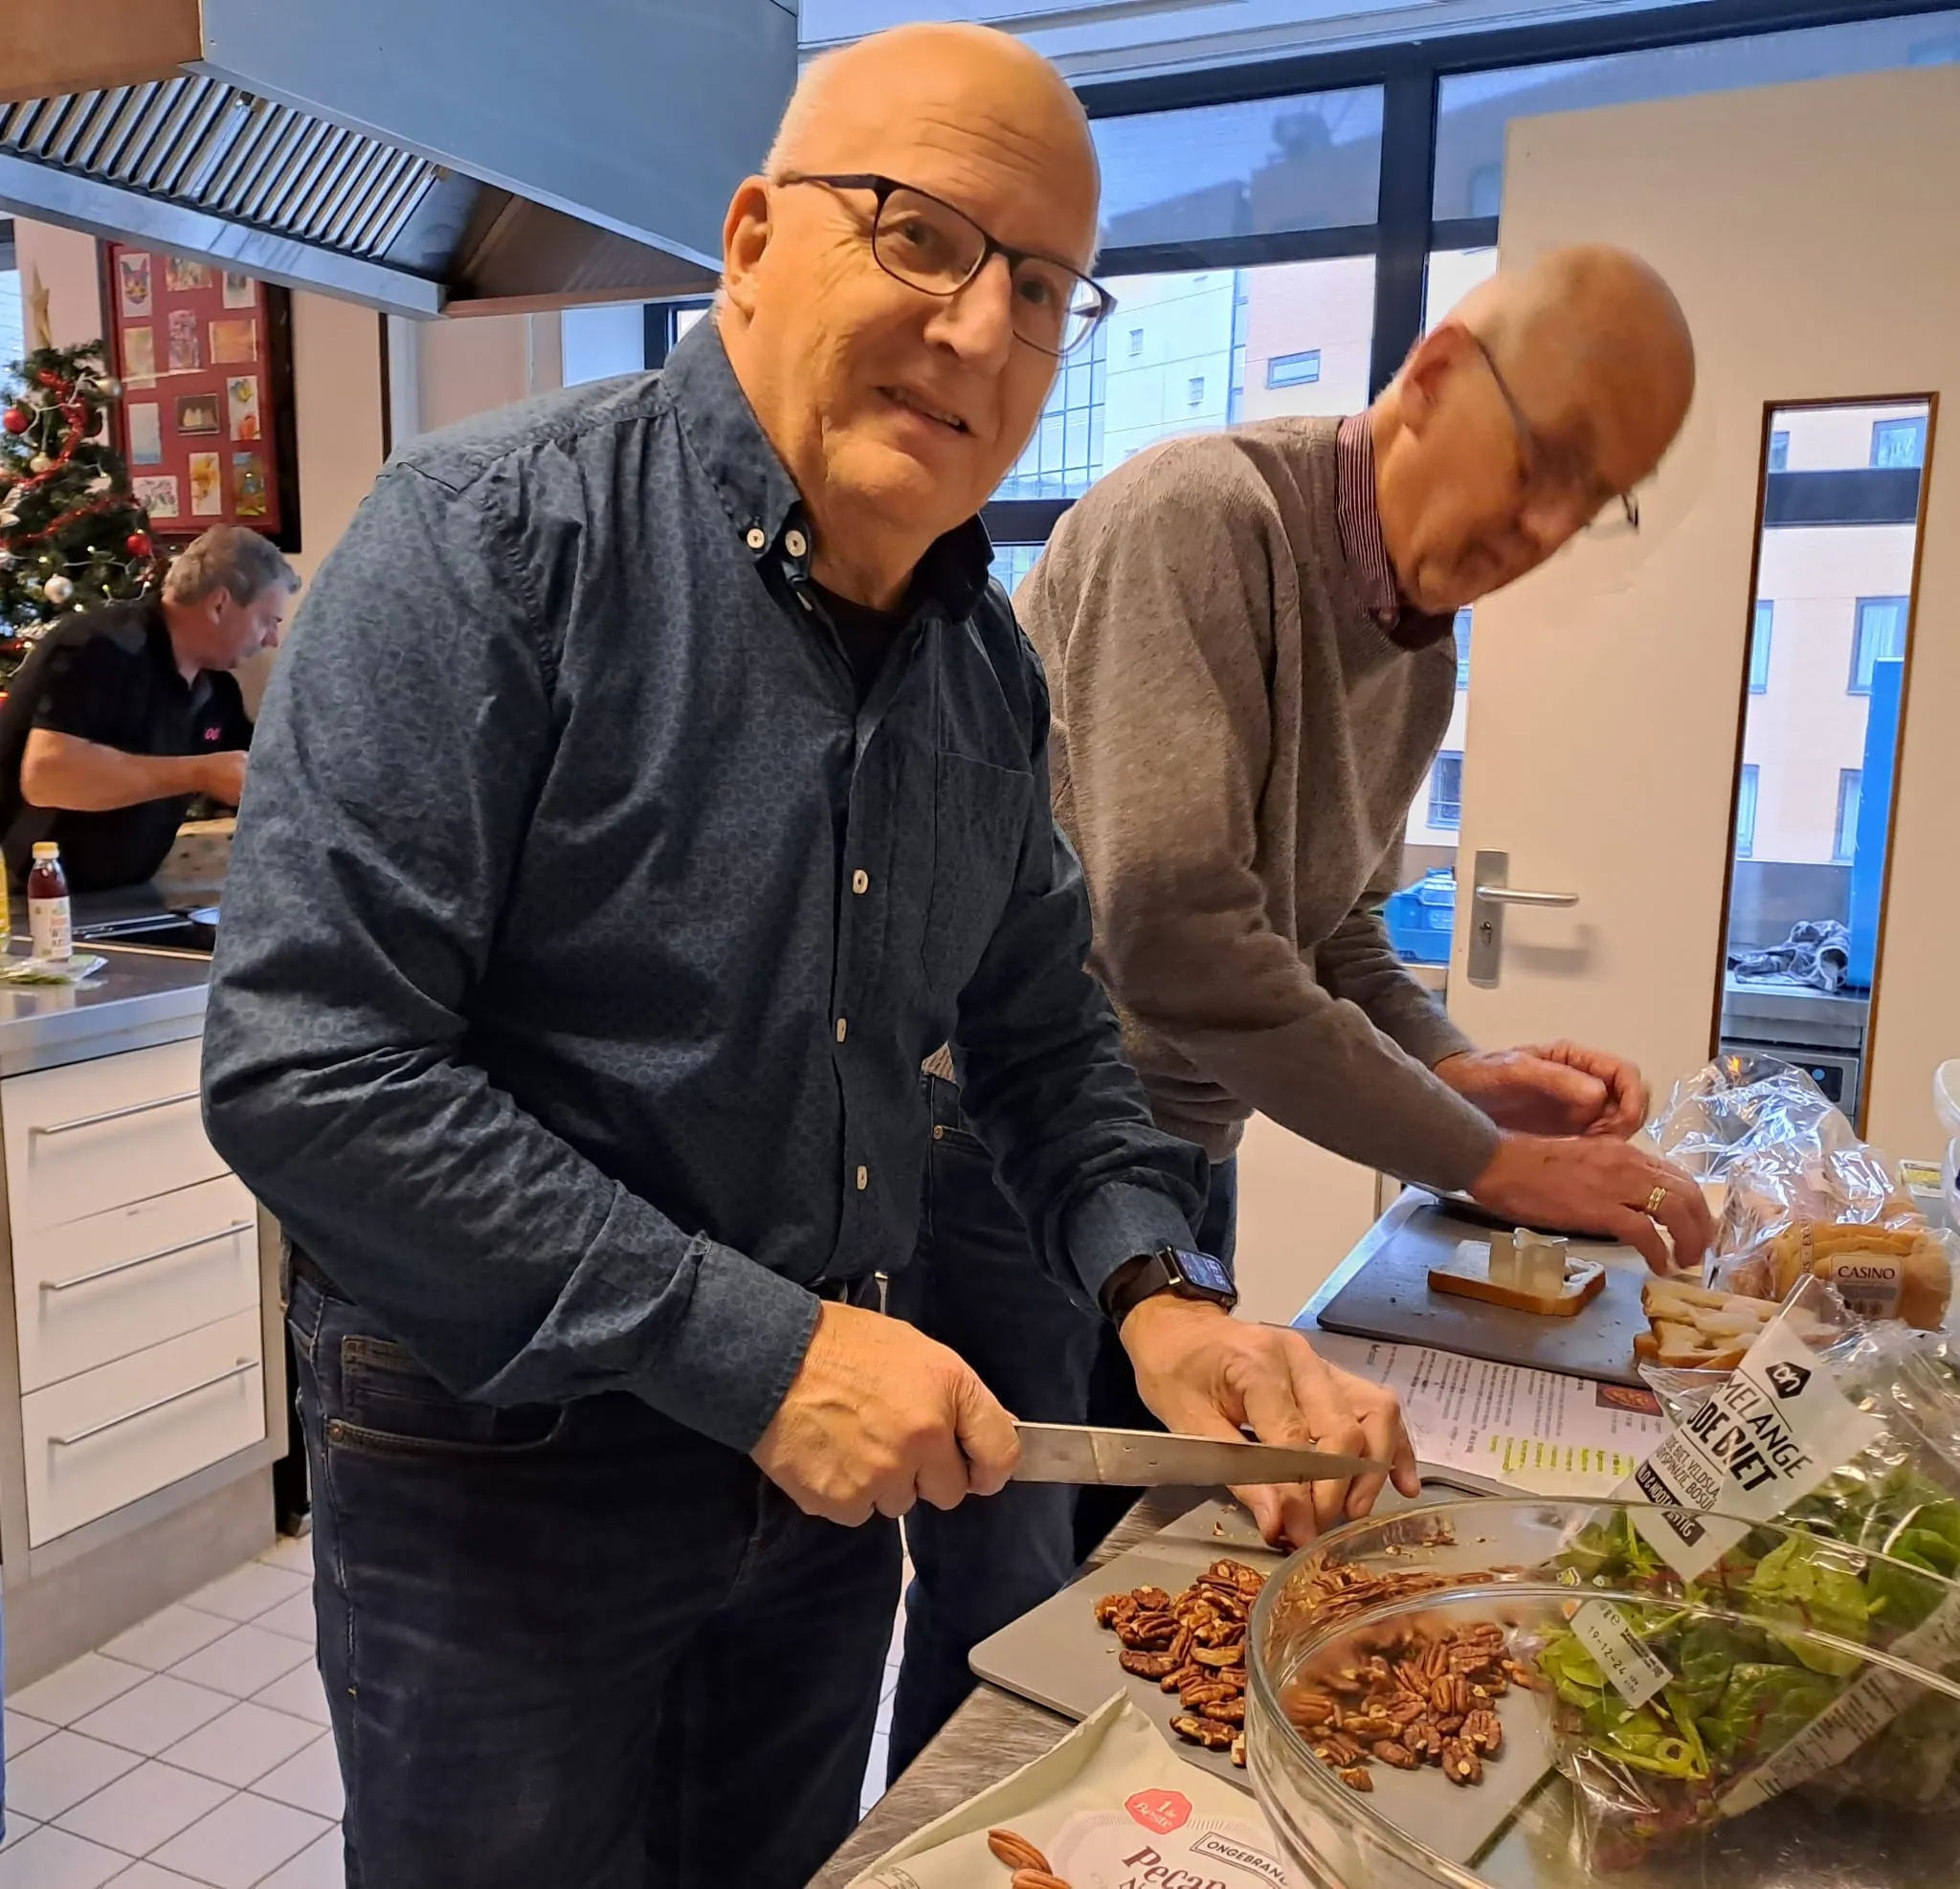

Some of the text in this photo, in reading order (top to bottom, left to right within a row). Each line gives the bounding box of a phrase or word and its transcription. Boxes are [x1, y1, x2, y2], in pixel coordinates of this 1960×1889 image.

[1838, 1265, 1896, 1280] CASINO
[1717, 1374, 1815, 1479] MELANGE
[1687, 1459, 1721, 1502] VELDSLA,
[1711, 1425, 1778, 1492] BIET
[1587, 1626, 1627, 1676] 19-12-24
